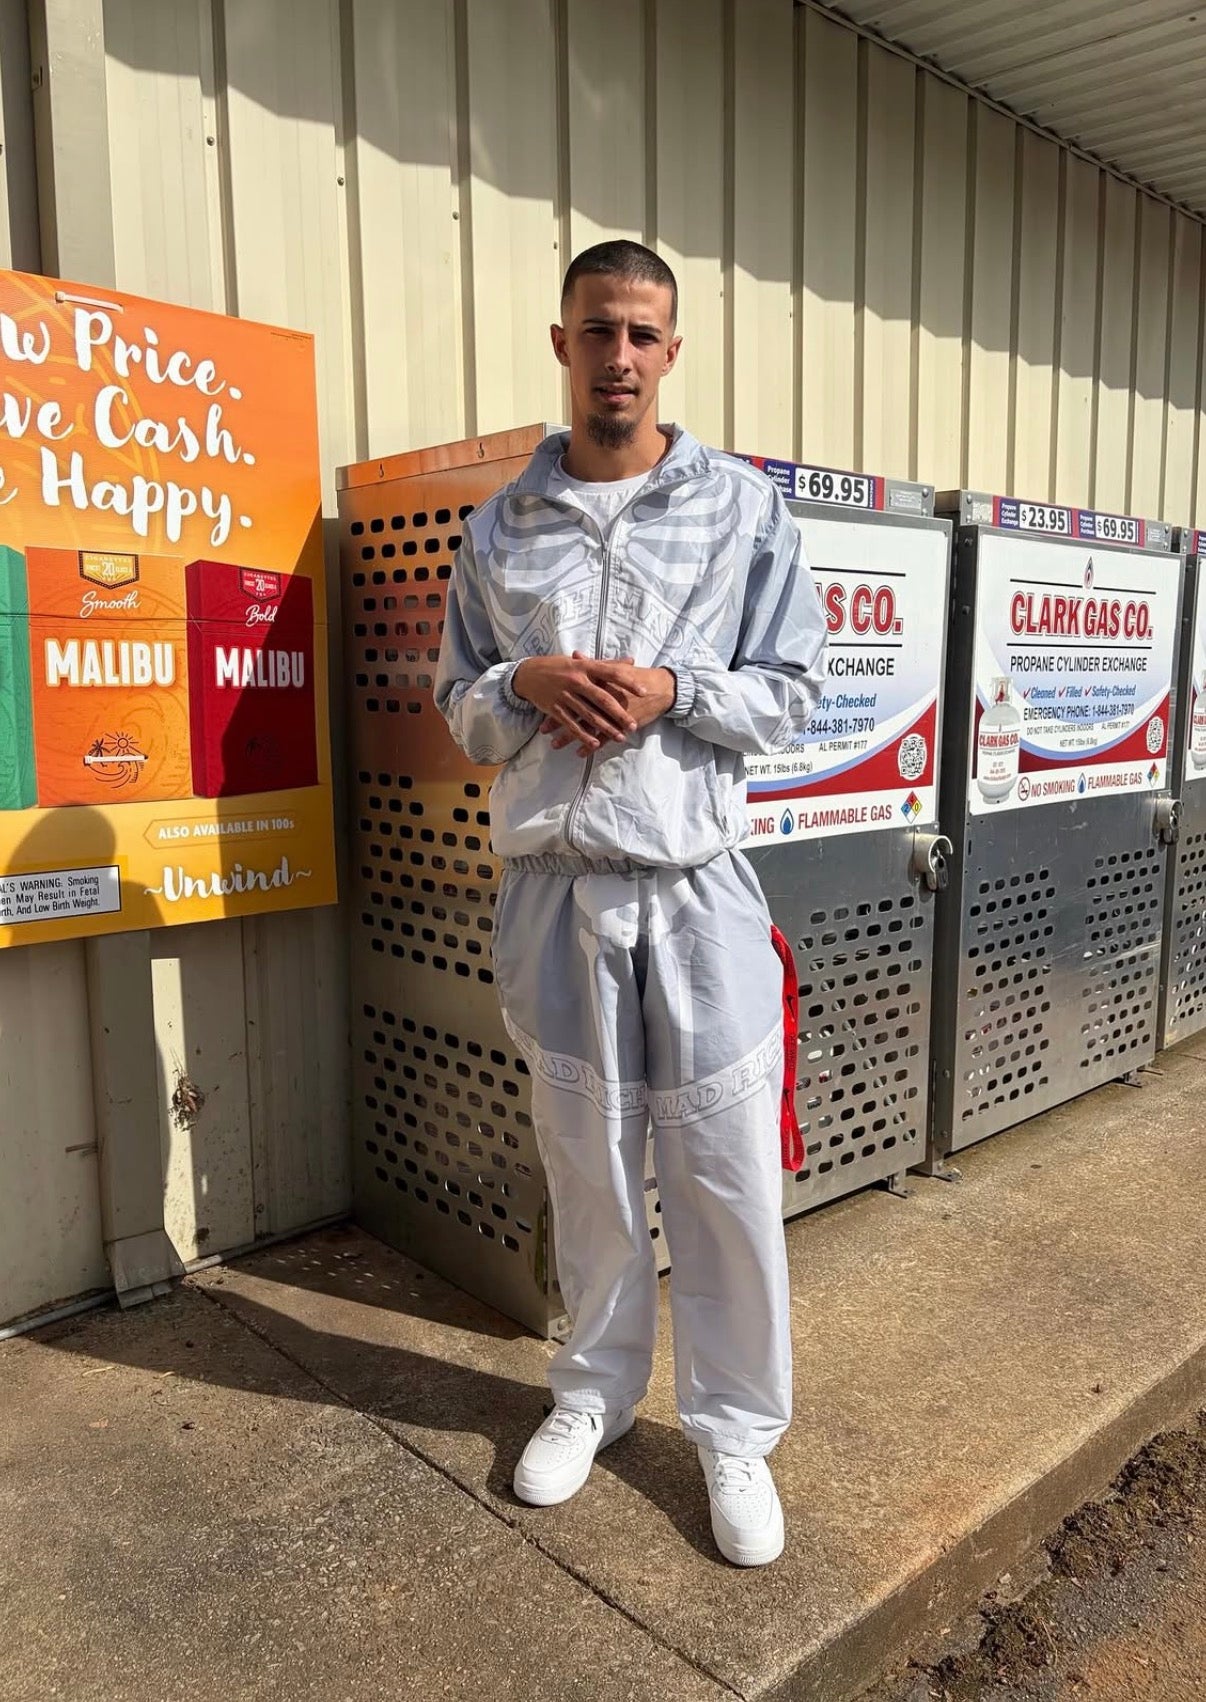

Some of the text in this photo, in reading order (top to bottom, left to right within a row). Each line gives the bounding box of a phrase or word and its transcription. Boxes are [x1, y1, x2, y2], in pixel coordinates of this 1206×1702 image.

[75, 308, 242, 400] Price.
[94, 385, 256, 465] Cash.
[40, 446, 252, 547] Happy.
[798, 472, 865, 503] $69.95
[1021, 506, 1065, 531] $23.95
[1097, 518, 1134, 540] $69.95
[79, 591, 141, 618] Smooth
[245, 604, 278, 628] Bold
[850, 584, 904, 635] CO.
[1010, 590, 1154, 641] CLARK GAS CO.
[45, 639, 175, 687] MALIBU
[214, 646, 305, 687] MALIBU
[1010, 656, 1148, 672] PROPANE CYLINDER EXCHANGE
[1065, 686, 1083, 698] Filled
[1091, 684, 1137, 699] Safety-Checked
[1023, 707, 1066, 721] EMERGENCY
[1066, 705, 1091, 718] PHONE:
[818, 742, 828, 752] AL
[829, 740, 853, 751] PERMIT
[979, 734, 998, 748] CLARK
[998, 734, 1010, 747] GAS
[773, 763, 790, 773] 15lbs
[1031, 771, 1142, 797] NO SMOKING FLAMMABLE GAS
[158, 818, 295, 840] ALSO AVAILABLE IN 100s
[798, 806, 868, 829] FLAMMABLE
[870, 804, 892, 821] GAS
[16, 893, 34, 904] May
[38, 889, 65, 900] Result
[68, 888, 77, 898] in
[80, 885, 100, 896] Fetal
[20, 877, 63, 891] WARNING:
[68, 875, 99, 886] Smoking
[16, 905, 31, 915] And
[35, 903, 50, 913] Low
[52, 900, 71, 911] Birth
[655, 1080, 724, 1121] MAD
